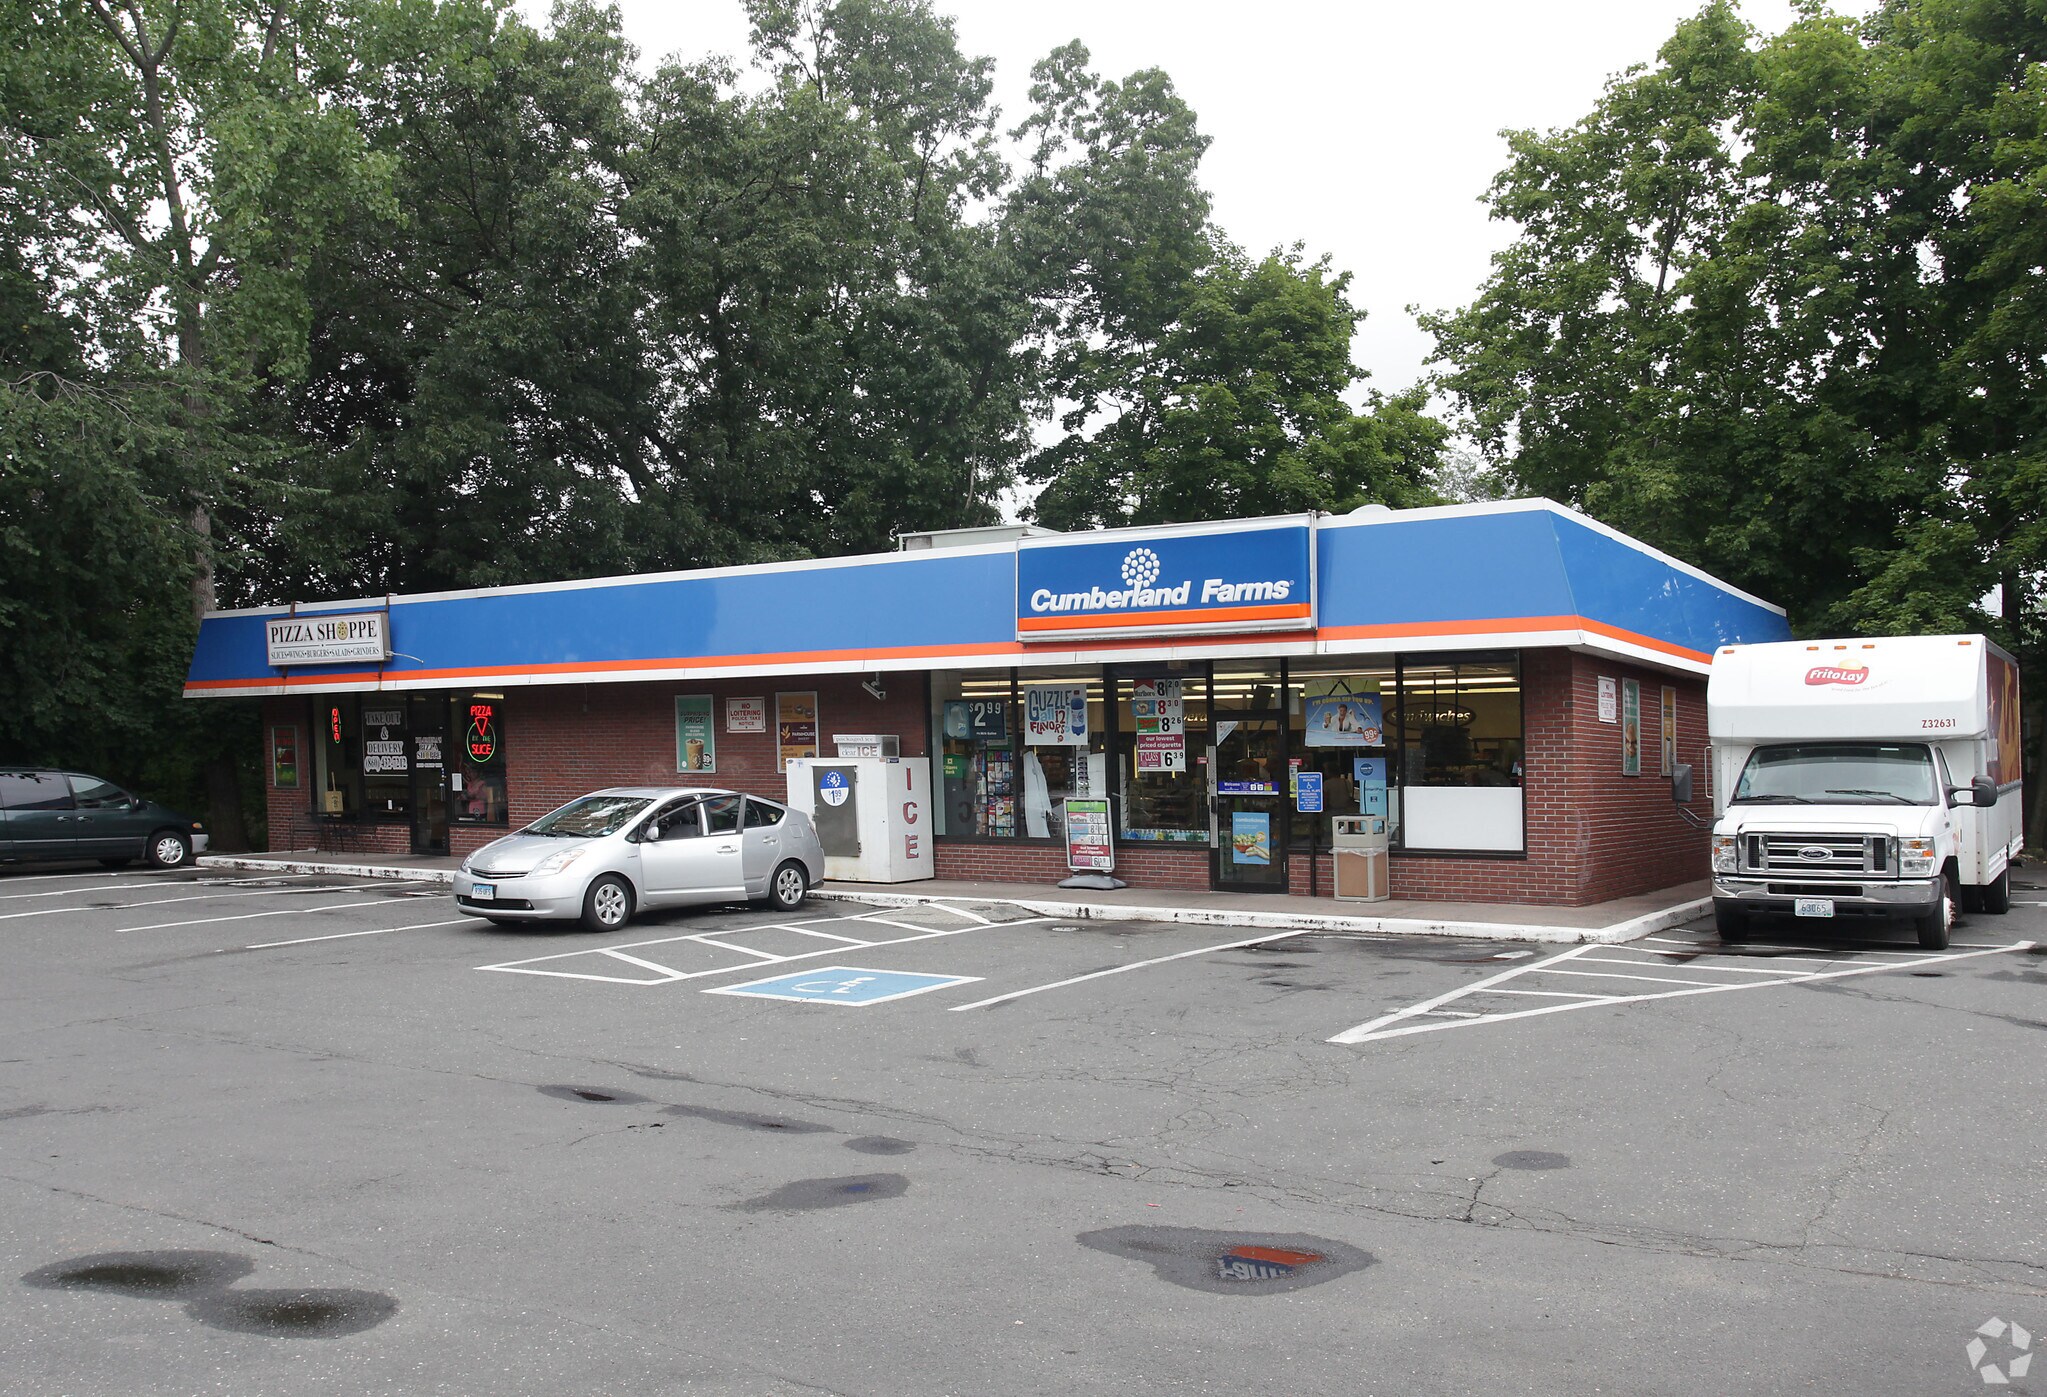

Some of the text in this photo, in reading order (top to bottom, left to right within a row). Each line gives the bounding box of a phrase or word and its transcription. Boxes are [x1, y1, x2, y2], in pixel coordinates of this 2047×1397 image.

[1030, 579, 1290, 612] Cumberland Farms
[271, 620, 377, 643] PIZZA SHOPPE
[471, 706, 491, 716] PIZZA
[1029, 690, 1071, 721] GUZZLE
[366, 712, 401, 725] TAKE OUT
[1040, 708, 1054, 721] all
[332, 708, 340, 740] OPEN
[1922, 719, 1956, 728] Z32631
[381, 726, 389, 740] &
[367, 742, 403, 754] DELIVERY
[472, 744, 491, 754] SLICE
[857, 746, 877, 756] ICE
[1802, 904, 1826, 912] 63065
